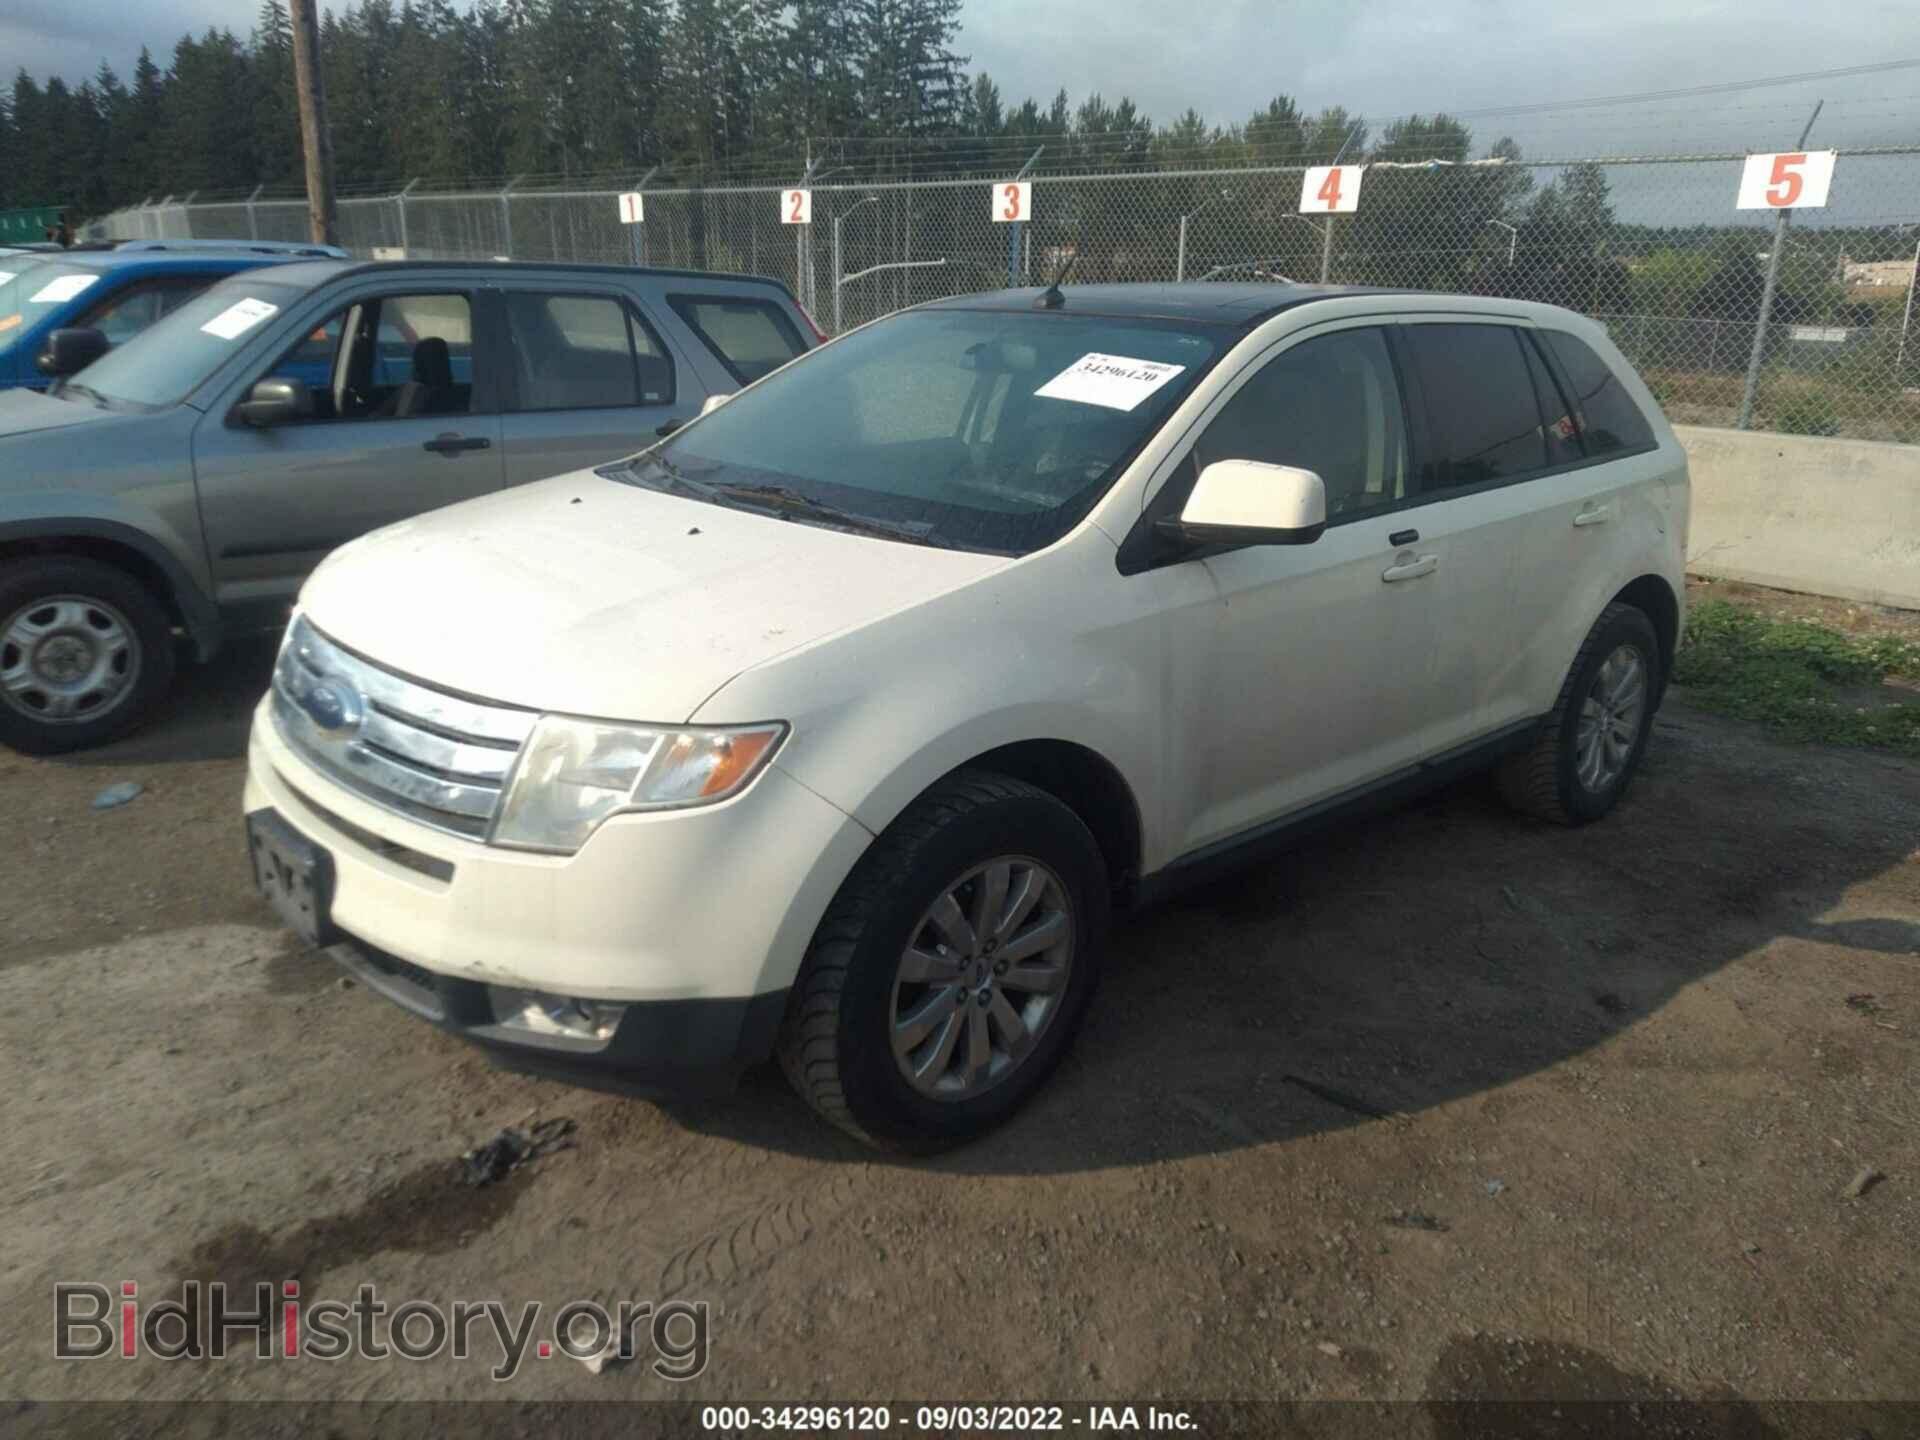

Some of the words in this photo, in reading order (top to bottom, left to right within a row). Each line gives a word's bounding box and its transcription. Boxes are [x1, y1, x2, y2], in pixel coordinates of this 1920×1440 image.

[1317, 168, 1342, 209] 4
[1765, 154, 1806, 207] 5
[791, 191, 803, 221] 2
[1003, 184, 1020, 220] 3
[1083, 362, 1159, 382] 34296120
